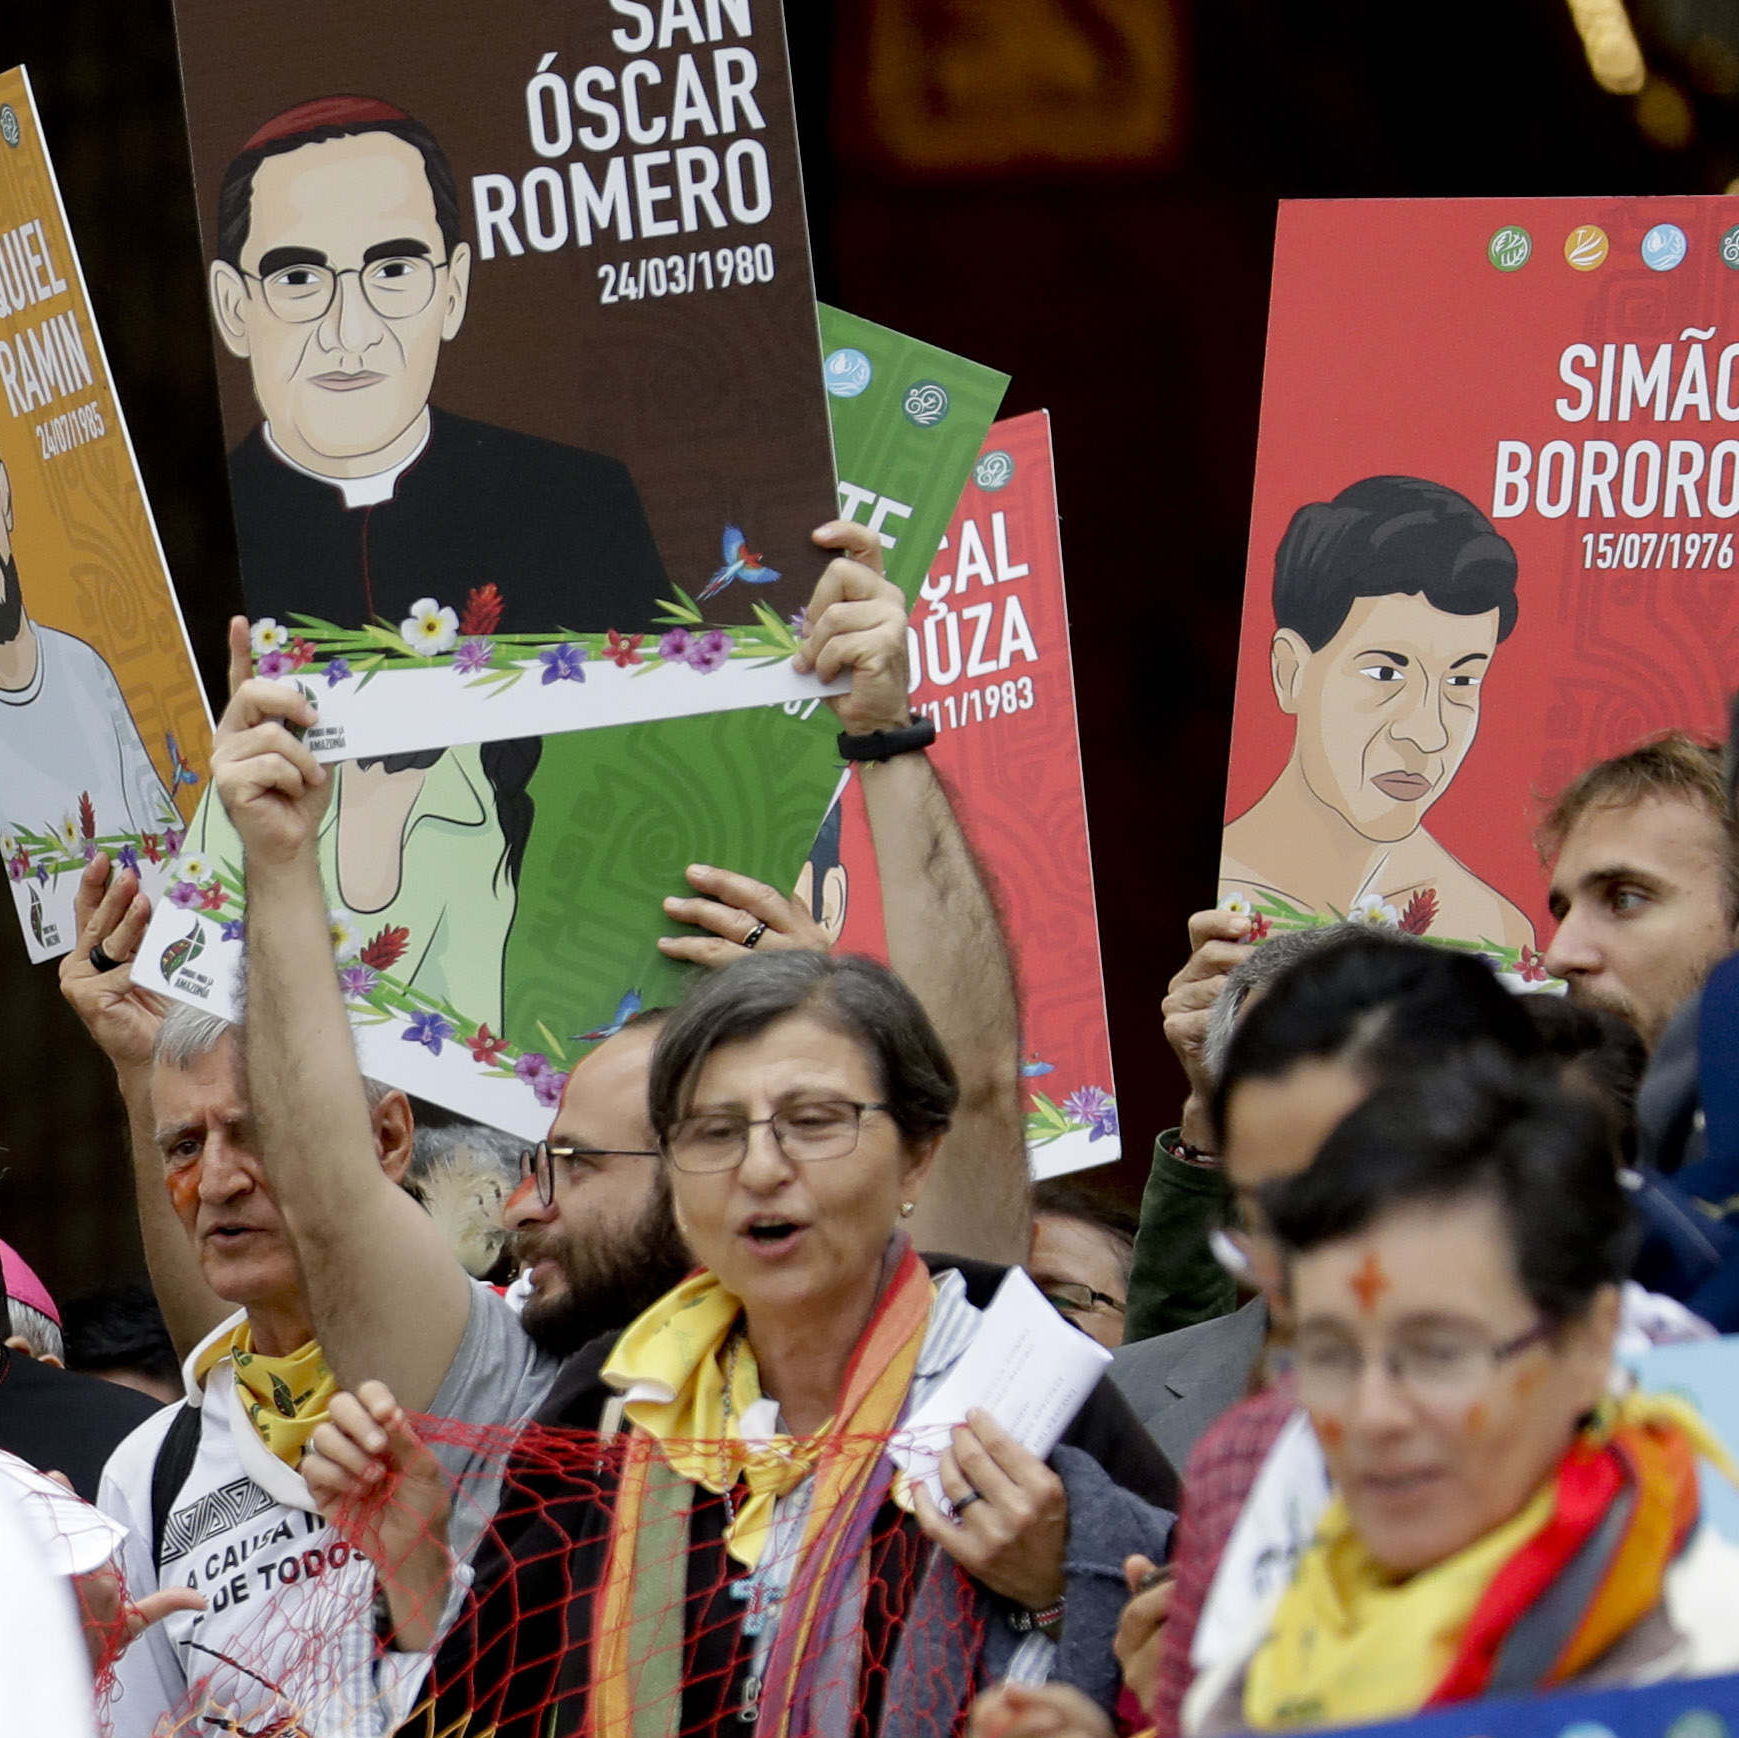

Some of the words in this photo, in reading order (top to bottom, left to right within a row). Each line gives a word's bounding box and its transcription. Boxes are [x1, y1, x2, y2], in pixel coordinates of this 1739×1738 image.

[525, 46, 767, 158] ÓSCAR
[472, 139, 773, 261] ROMERO
[598, 242, 775, 305] 24/03/1980
[1556, 326, 1739, 422] SIMÃO
[36, 400, 105, 460] 24/07/1985
[1493, 439, 1739, 519] BORORO
[1582, 532, 1735, 570] 15/07/1976
[186, 1569, 200, 1592] A
[205, 1518, 294, 1582] CAUSA
[212, 1573, 250, 1614] DE
